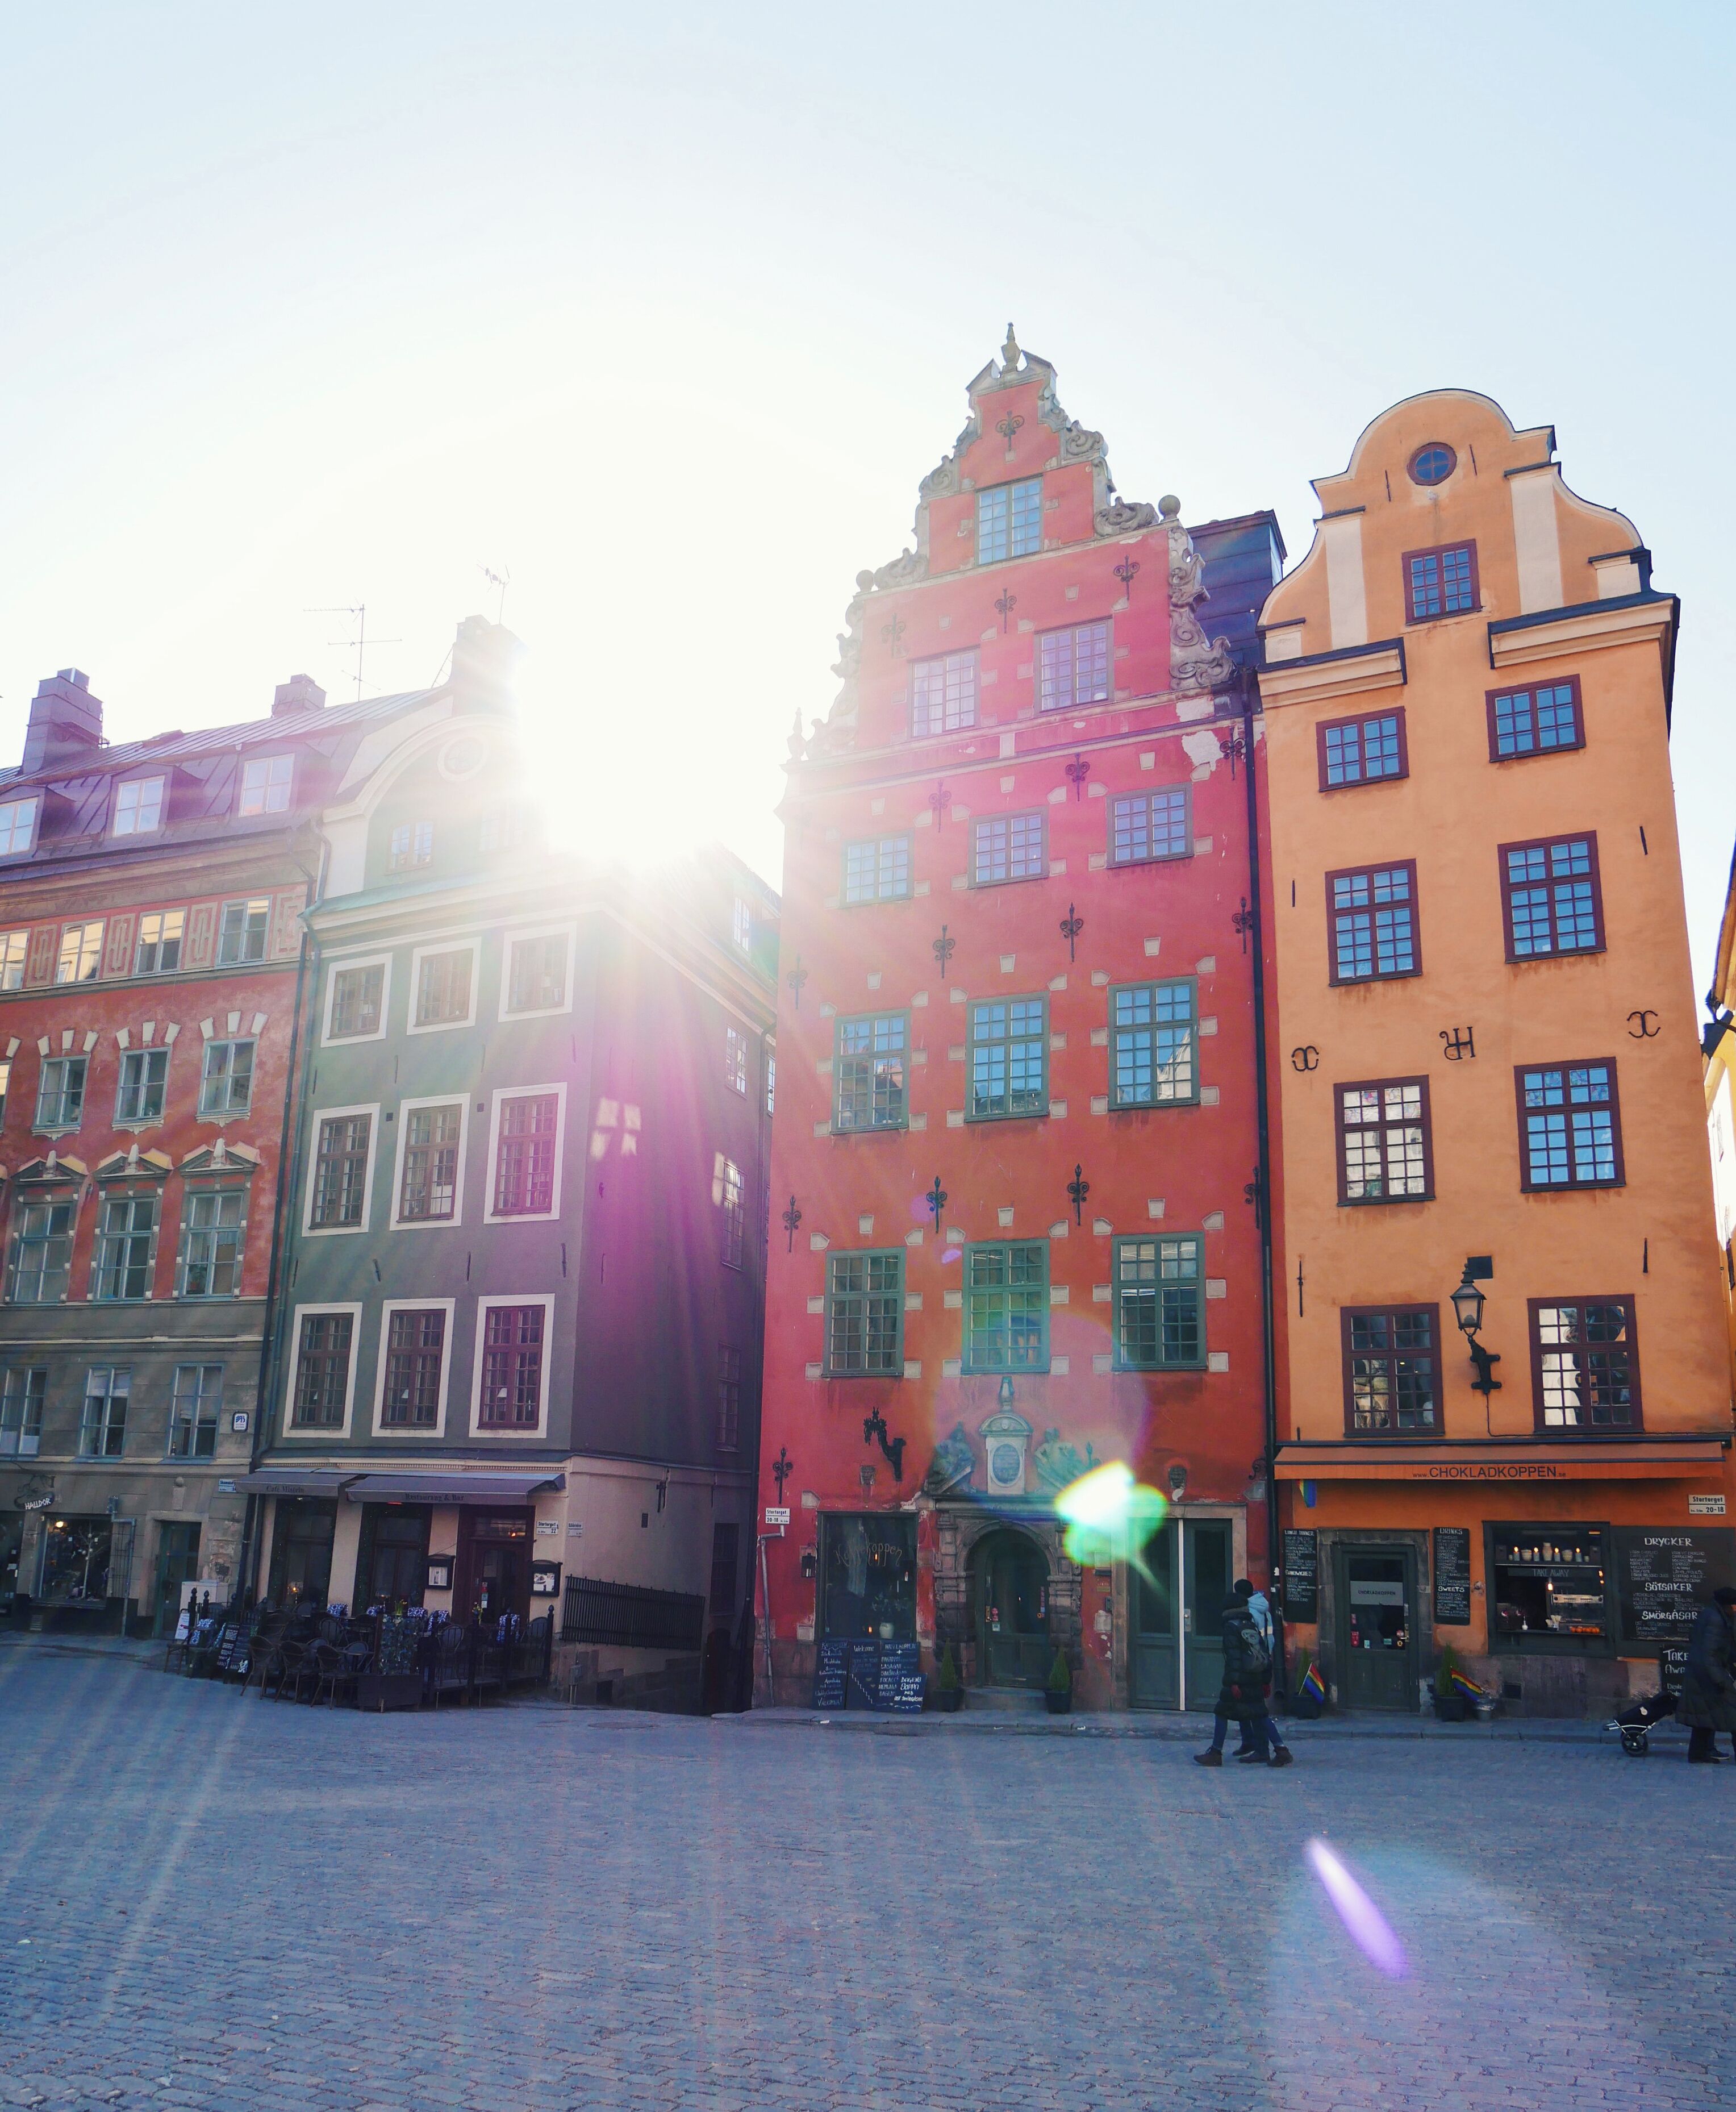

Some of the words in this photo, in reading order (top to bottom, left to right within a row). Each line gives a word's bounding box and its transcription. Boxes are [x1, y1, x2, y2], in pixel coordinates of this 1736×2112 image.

[1644, 1537, 1693, 1547] DRYCKER
[1645, 1581, 1693, 1592] SÖTSAKER
[1642, 1610, 1697, 1620] SMÖRGÅSAR
[1663, 1648, 1689, 1661] TAKE
